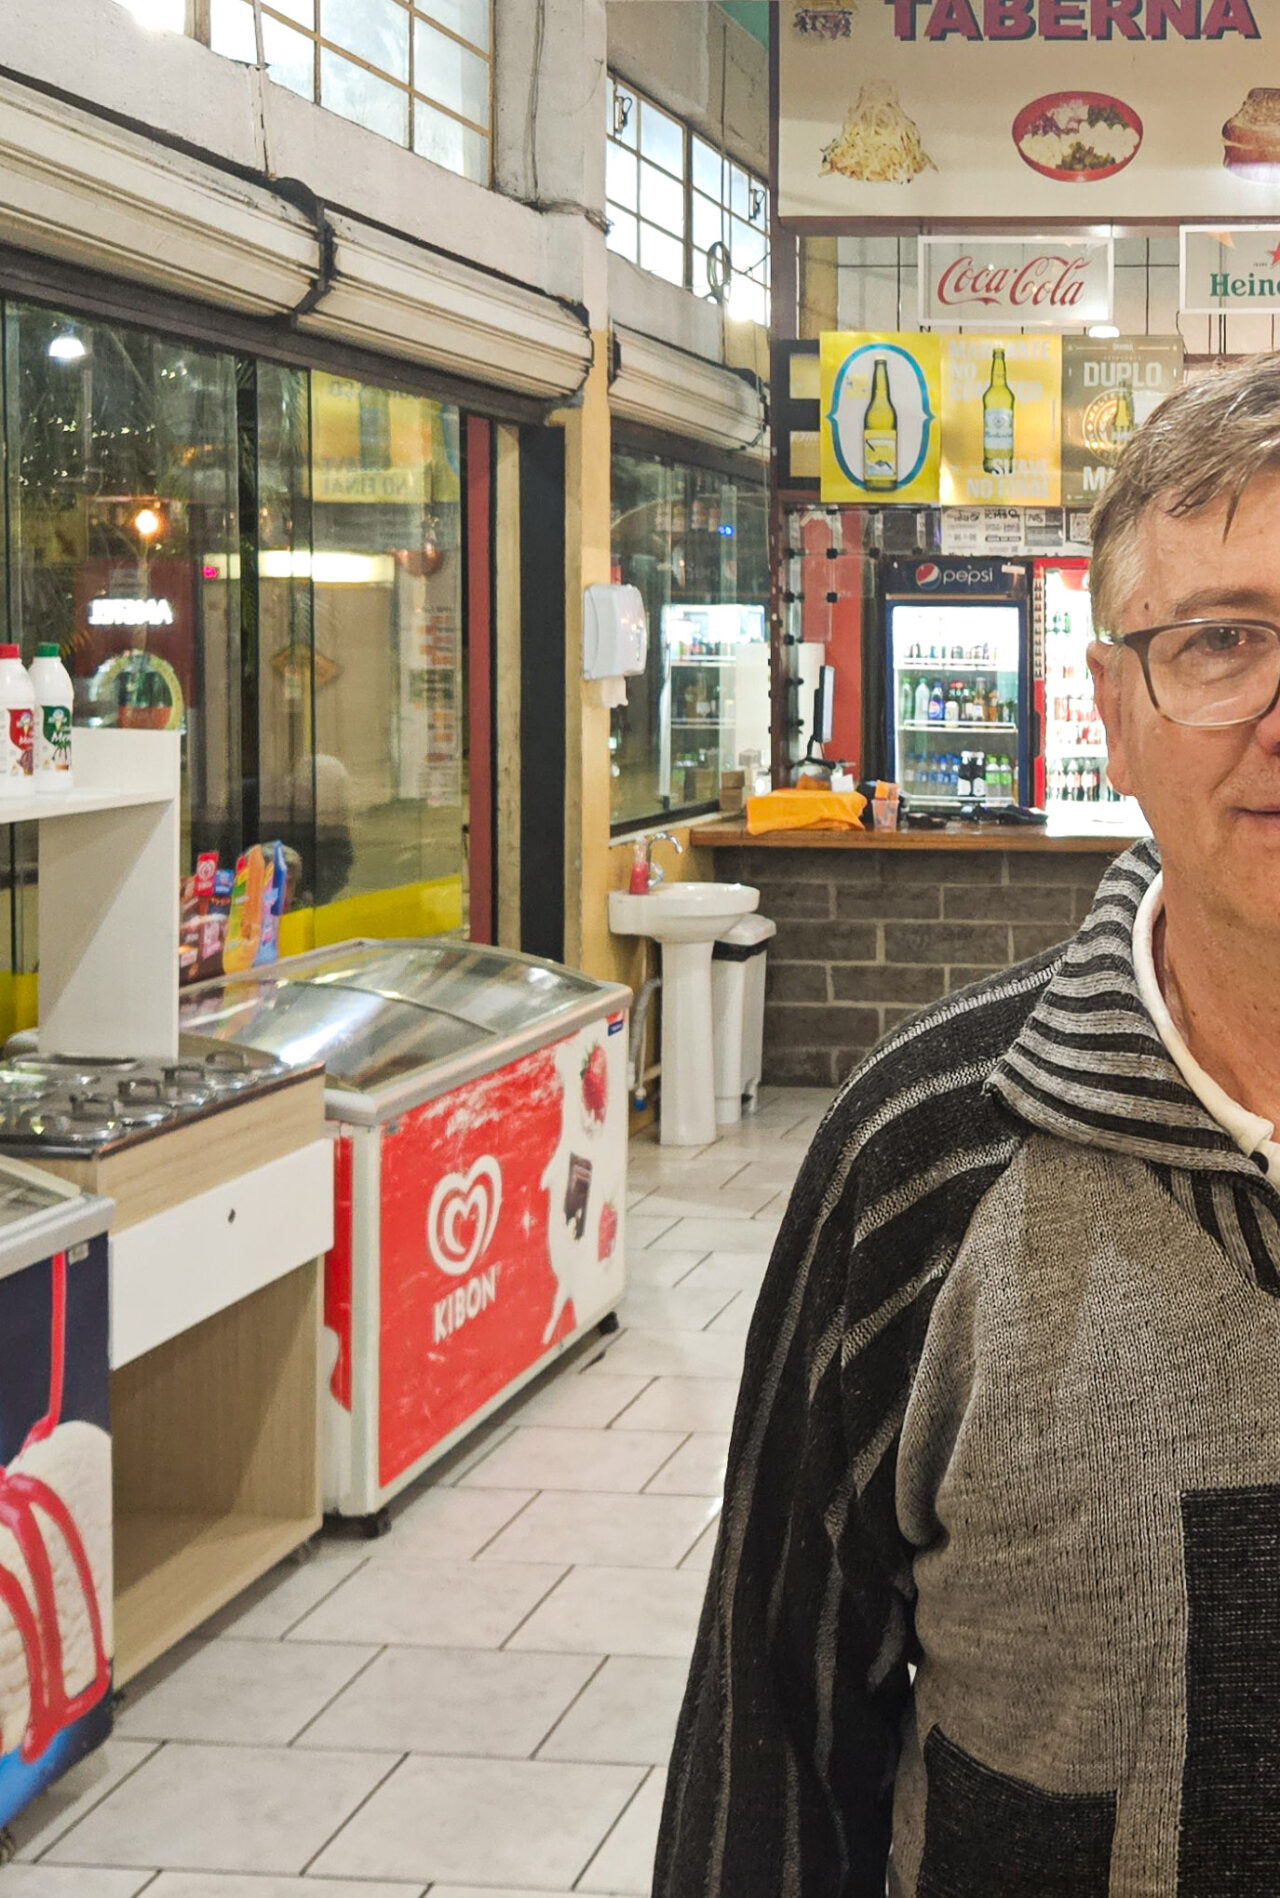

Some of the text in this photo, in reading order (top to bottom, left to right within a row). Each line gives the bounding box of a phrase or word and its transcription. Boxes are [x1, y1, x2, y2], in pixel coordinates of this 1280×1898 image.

[884, 0, 1261, 41] TABERNA
[1083, 361, 1163, 388] DUPLO
[942, 567, 994, 586] pepsi
[433, 1264, 498, 1346] KIBON
